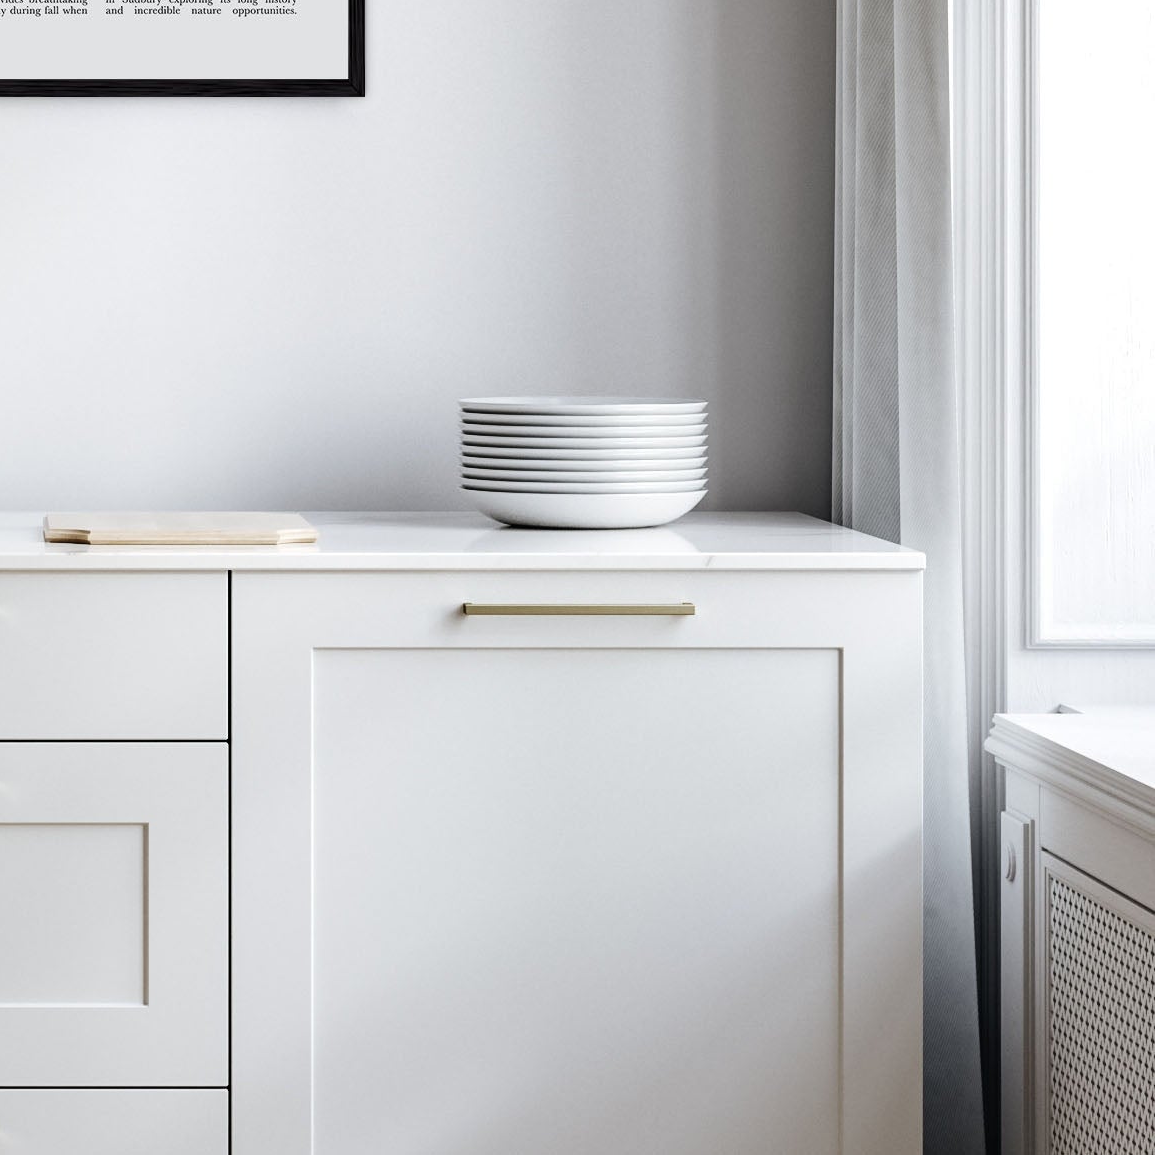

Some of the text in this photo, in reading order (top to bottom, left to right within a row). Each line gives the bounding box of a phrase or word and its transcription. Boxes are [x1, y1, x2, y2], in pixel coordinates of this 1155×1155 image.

[10, 6, 41, 16] during
[45, 6, 59, 14] fall
[62, 6, 88, 14] when
[105, 6, 297, 16] and incredible nature opportunities.
